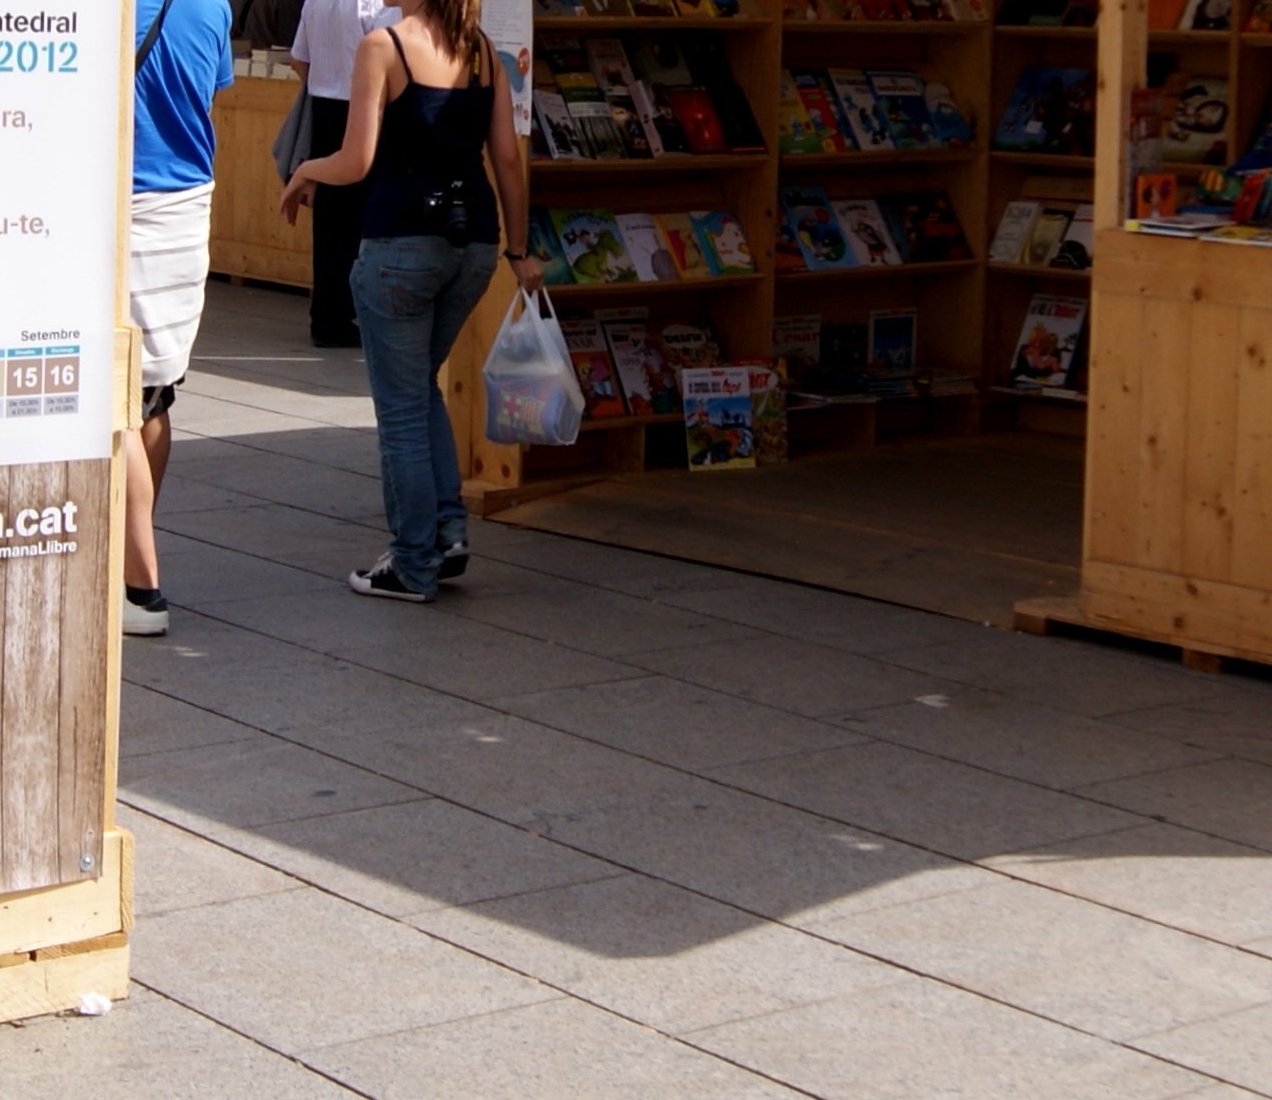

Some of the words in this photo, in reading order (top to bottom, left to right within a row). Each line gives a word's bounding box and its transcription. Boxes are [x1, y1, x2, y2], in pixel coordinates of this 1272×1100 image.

[20, 328, 81, 342] Setembre
[12, 367, 38, 389] 15
[50, 365, 75, 387] 16
